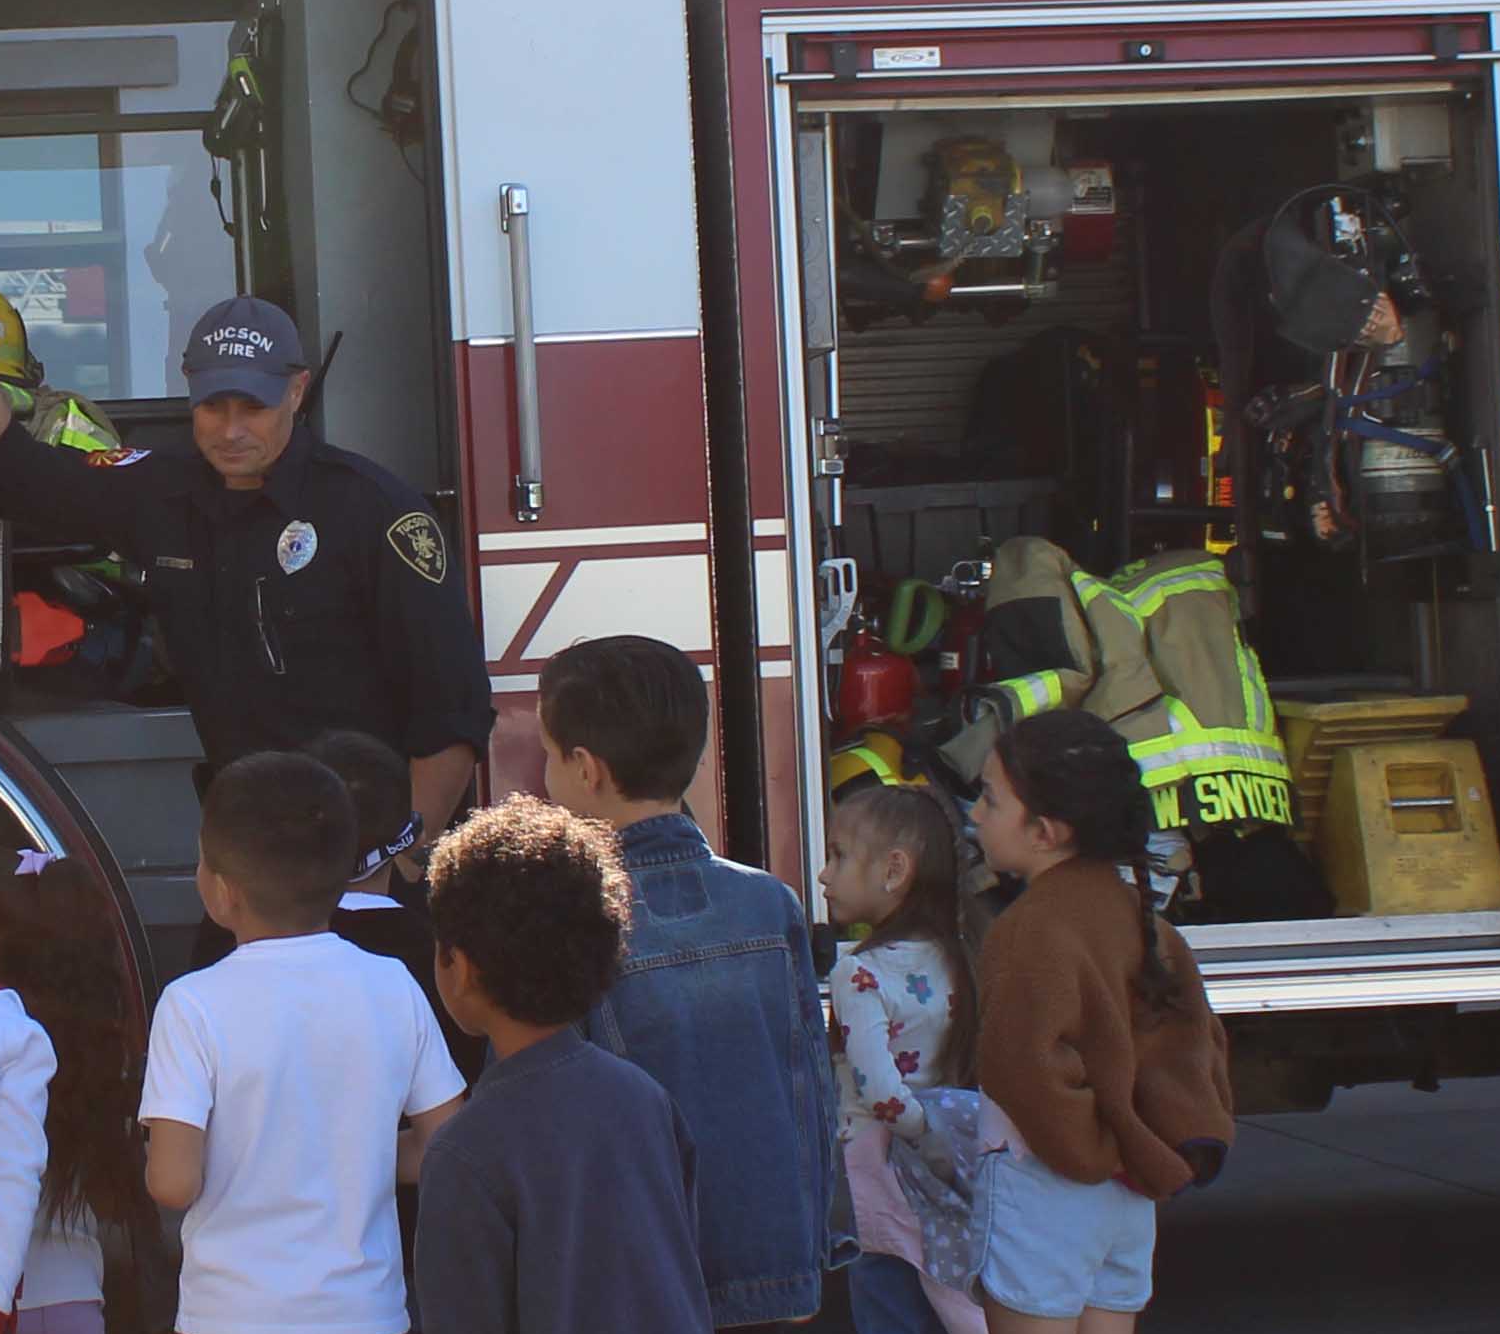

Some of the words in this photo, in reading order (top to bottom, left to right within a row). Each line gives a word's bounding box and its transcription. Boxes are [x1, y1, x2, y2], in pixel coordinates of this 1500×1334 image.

[202, 326, 273, 353] TUCSON
[218, 342, 256, 358] FIRE
[1152, 786, 1189, 829] W.
[1194, 773, 1294, 826] SNYDER
